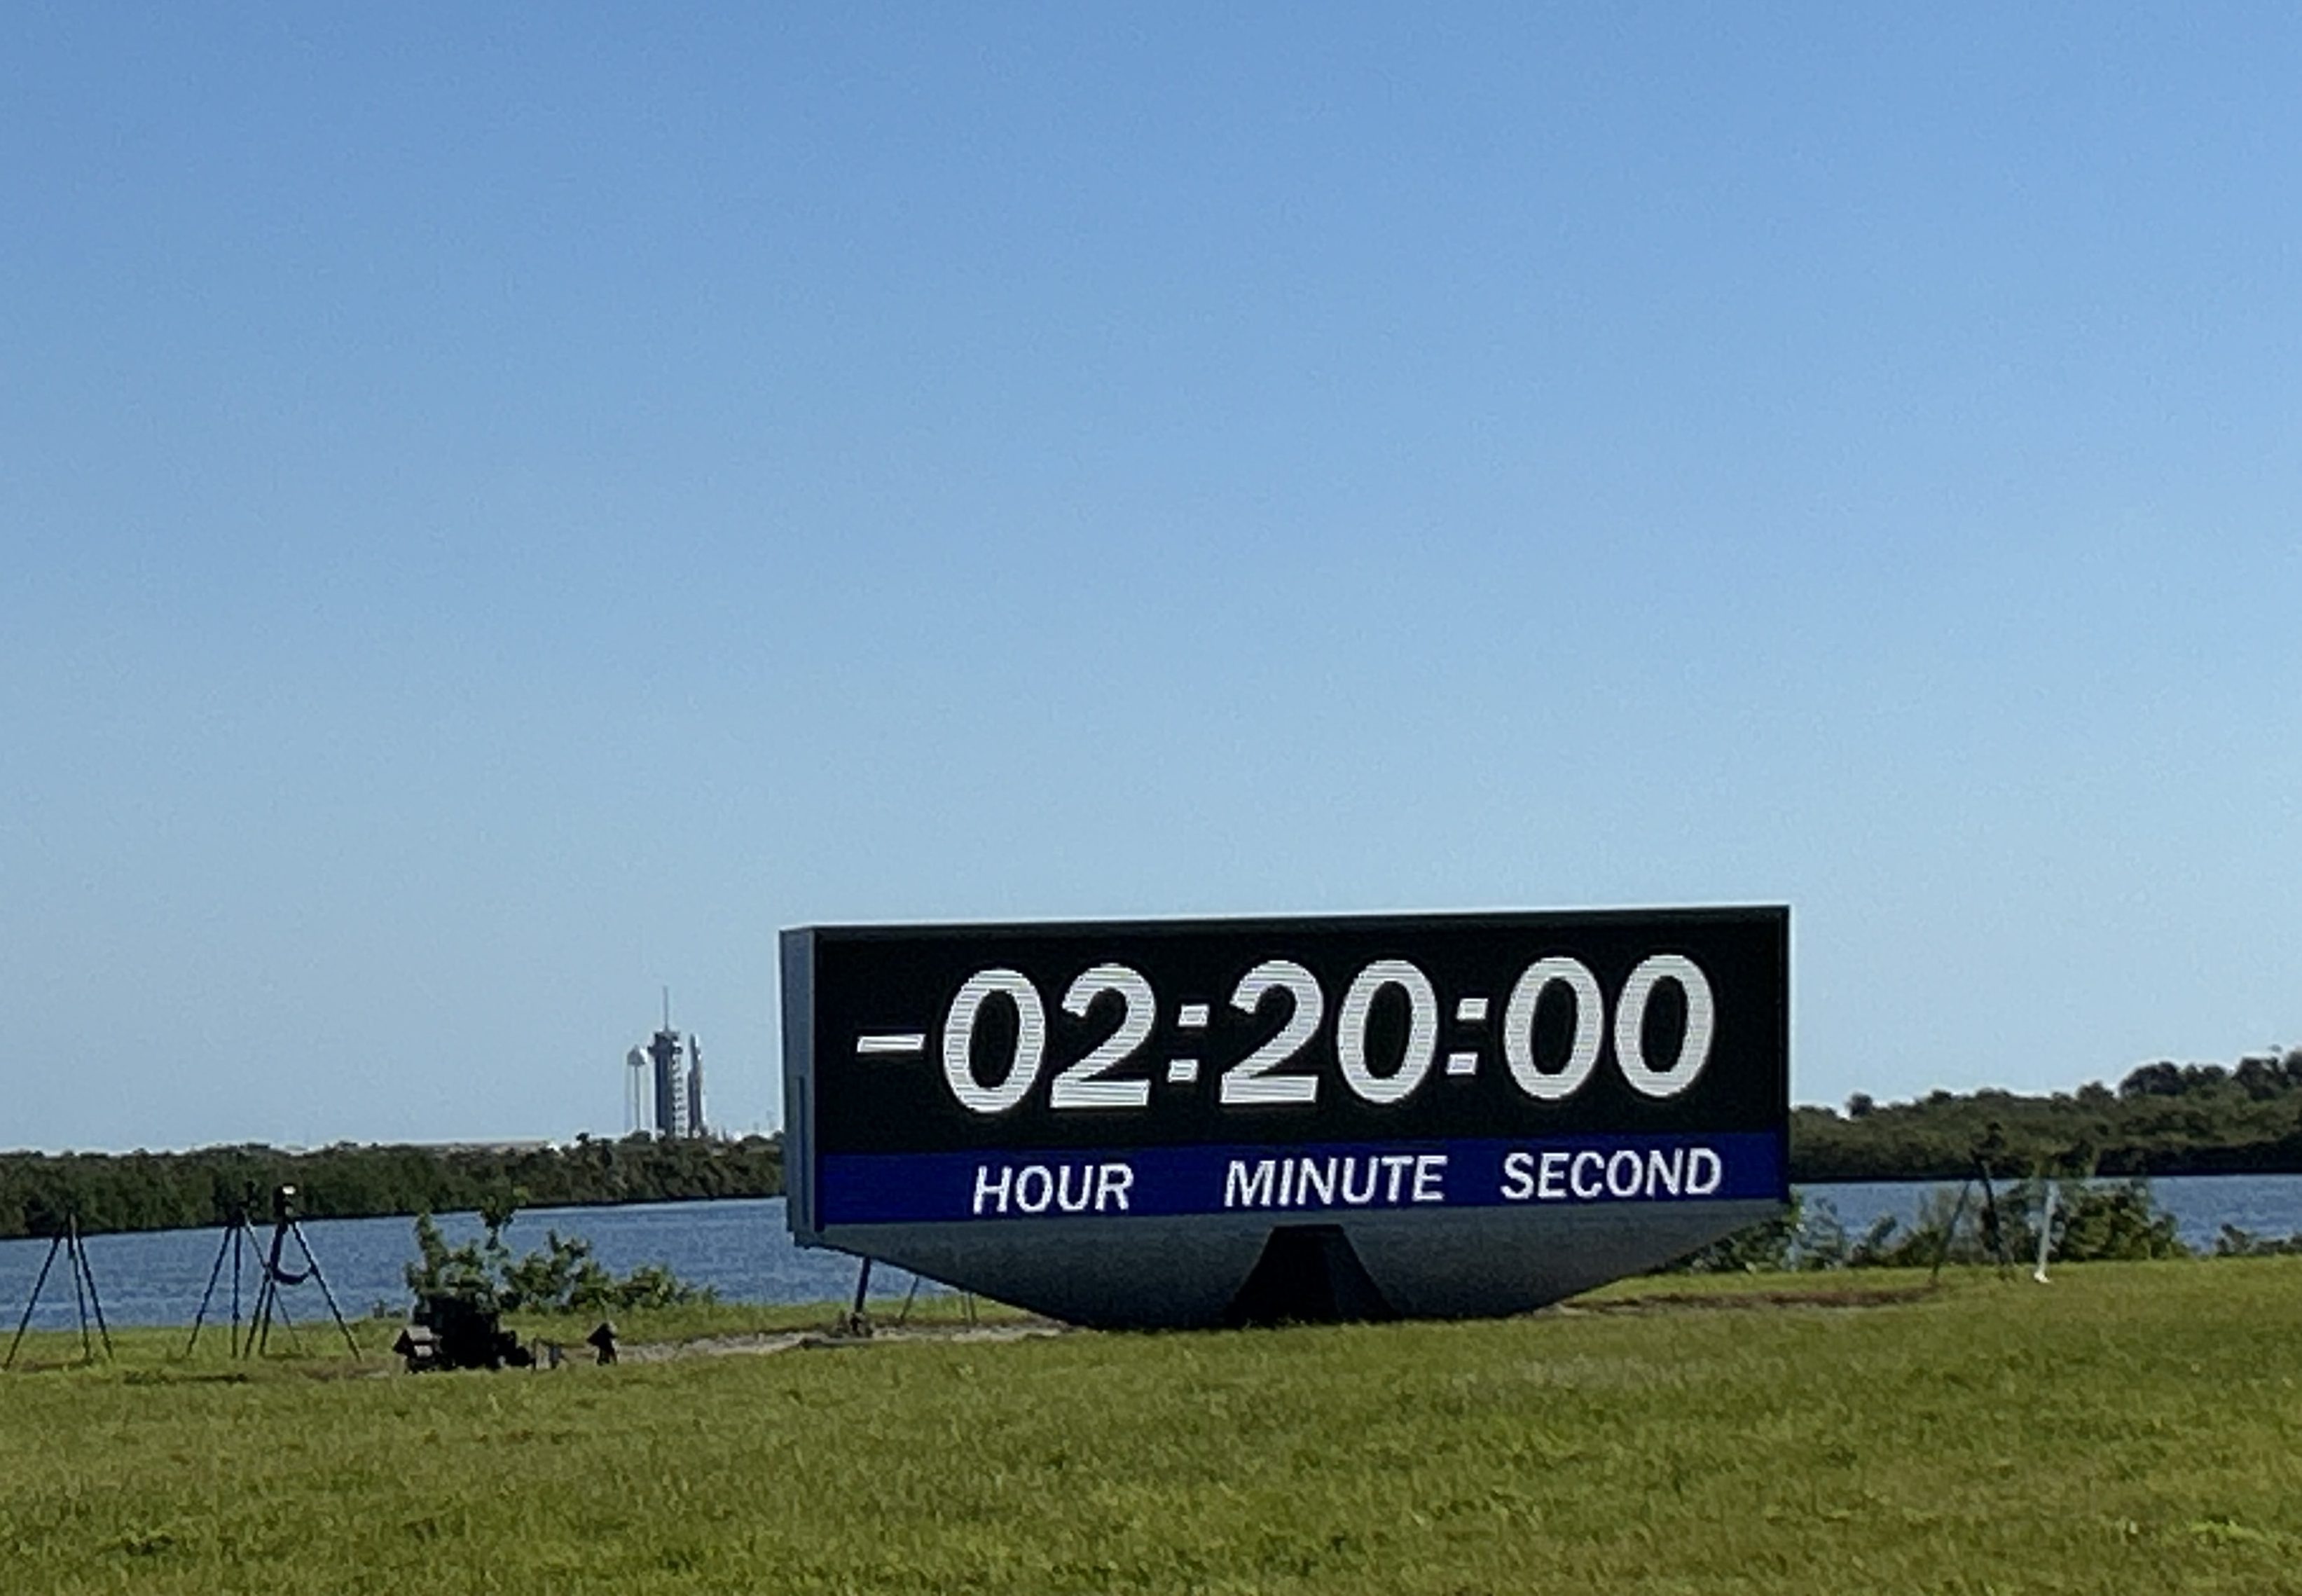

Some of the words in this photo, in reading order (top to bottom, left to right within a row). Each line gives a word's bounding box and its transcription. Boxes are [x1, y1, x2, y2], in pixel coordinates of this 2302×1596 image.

[857, 954, 1714, 1113] -02:20:00
[972, 1163, 1134, 1214] HOUR
[1224, 1155, 1447, 1207] MINUTE
[1501, 1148, 1721, 1200] SECOND
